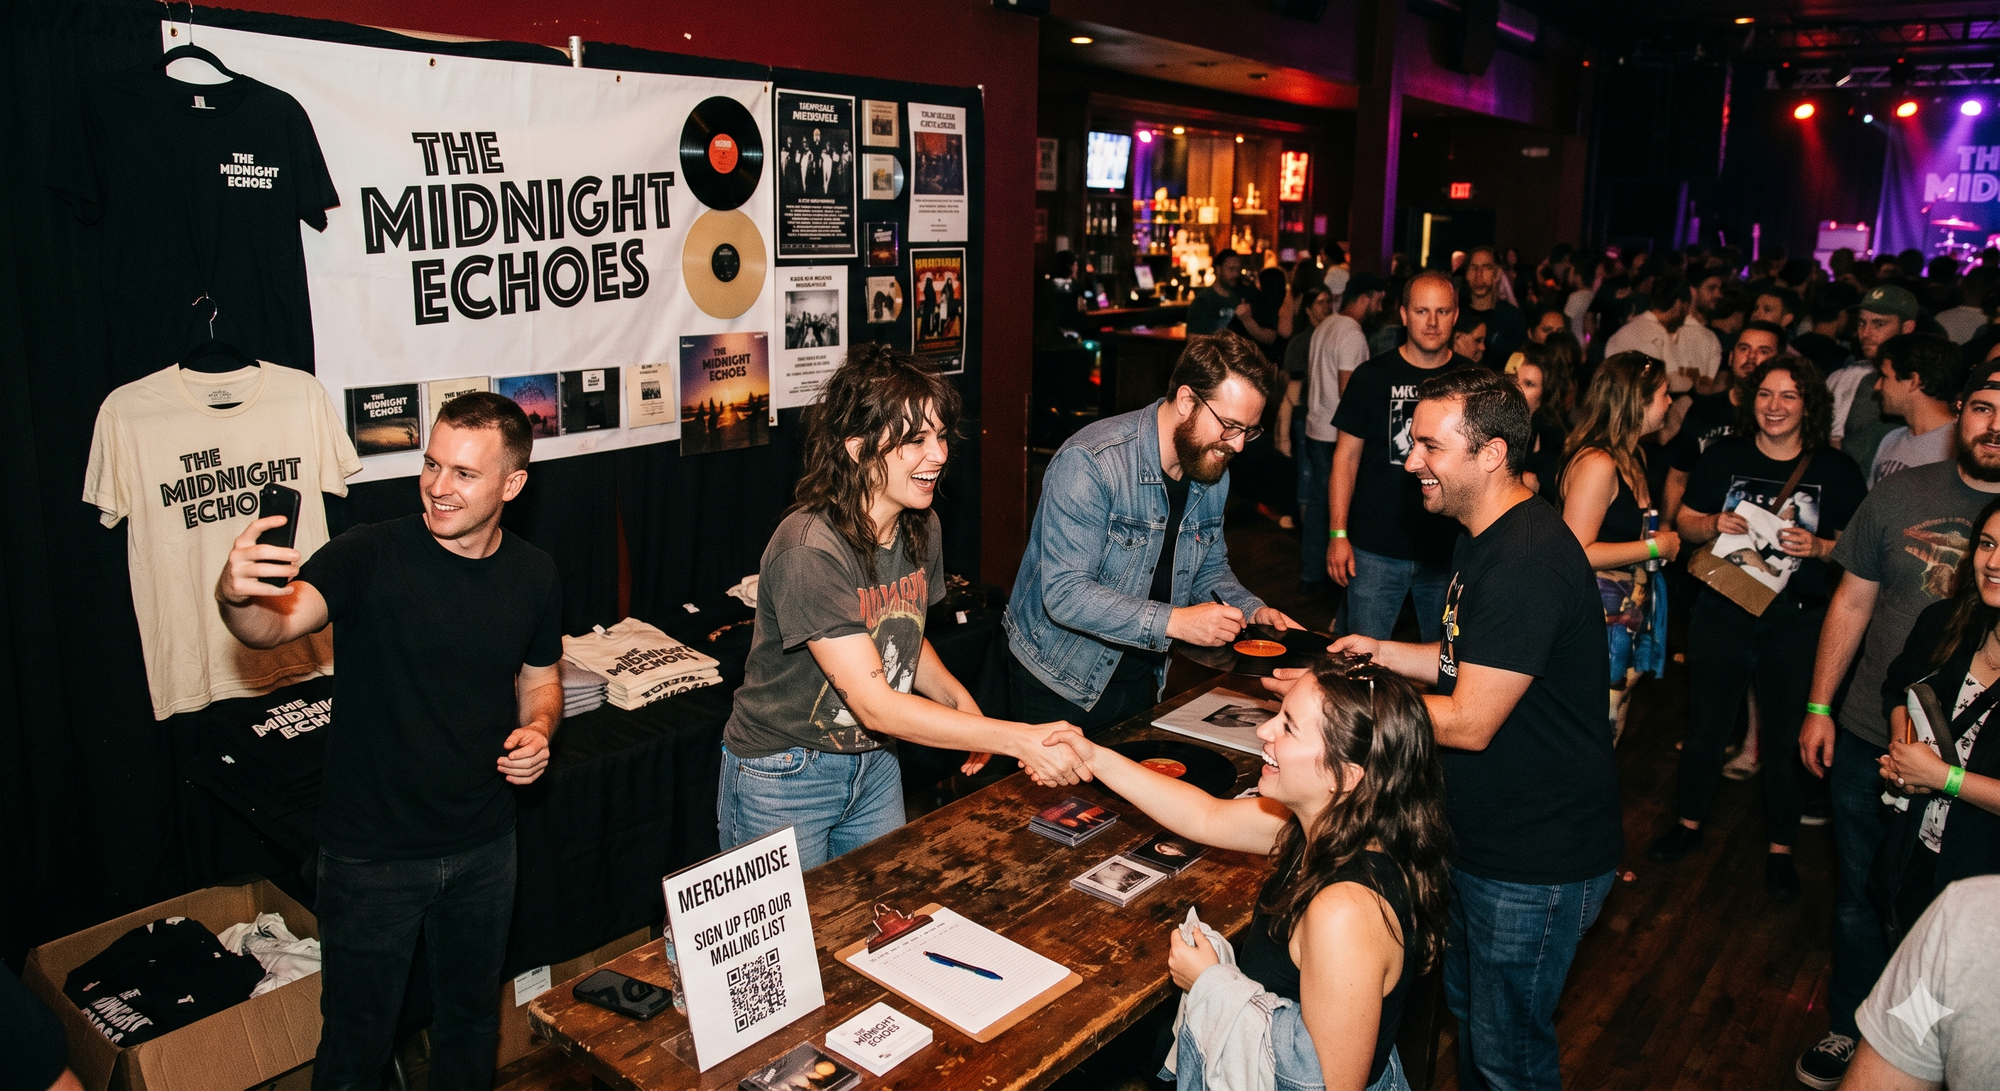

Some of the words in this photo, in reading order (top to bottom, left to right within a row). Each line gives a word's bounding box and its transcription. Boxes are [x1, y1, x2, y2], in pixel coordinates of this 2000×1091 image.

[232, 152, 254, 164] THE
[411, 131, 504, 176] THE
[1957, 145, 2000, 171] TH
[220, 163, 279, 178] MIDNIGHT
[228, 176, 273, 189] ECHOES
[1923, 172, 2000, 203] MID
[361, 171, 675, 254] MIDNIGHT
[411, 238, 650, 326] ECHOES
[702, 353, 751, 370] MIDNIGHT
[713, 347, 726, 356] THE
[709, 366, 746, 382] ECHOES
[363, 396, 408, 411] MIDNIGHT
[371, 393, 385, 401] THE
[370, 405, 403, 418] ECHOES
[179, 448, 222, 473] THE
[160, 457, 301, 507] MIDNIGHT
[183, 491, 259, 530] ECHO
[614, 647, 642, 661] THE
[266, 699, 308, 715] THE
[279, 712, 331, 740] ECH
[678, 845, 790, 914] MERCHANDISE
[694, 923, 723, 951] SIGN
[725, 915, 741, 936] UP
[743, 903, 767, 928] FOR
[768, 892, 792, 916] OUR
[710, 929, 760, 967] MAILING
[761, 915, 785, 941] LIST
[867, 1024, 900, 1047] ECHOES
